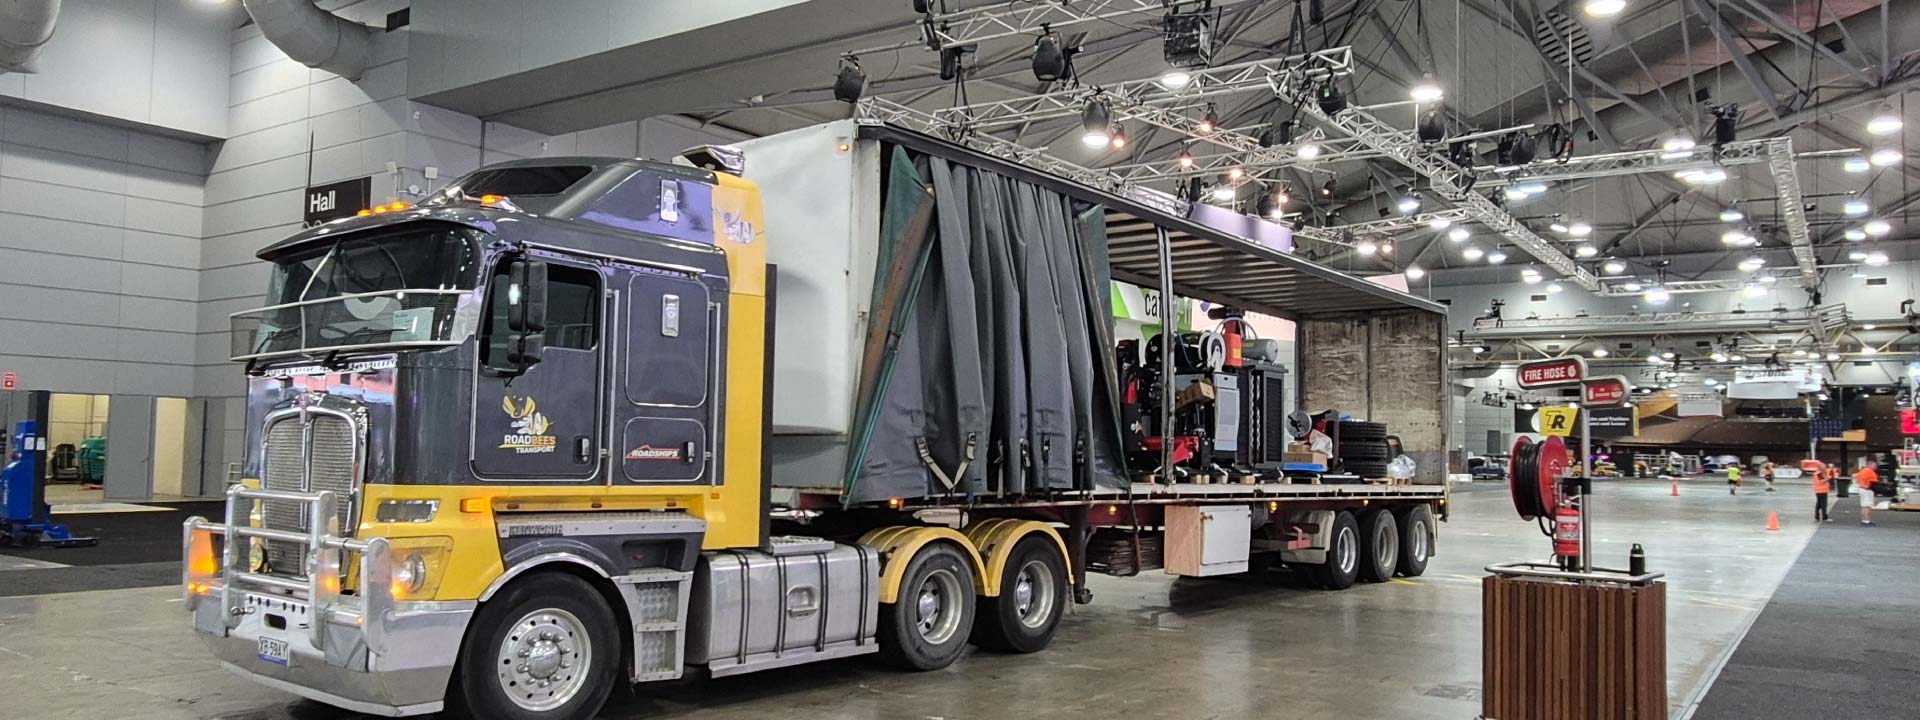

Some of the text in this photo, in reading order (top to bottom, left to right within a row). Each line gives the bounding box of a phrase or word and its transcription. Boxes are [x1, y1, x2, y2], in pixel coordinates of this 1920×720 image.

[310, 190, 336, 213] Hall
[1525, 367, 1566, 381] FIRE HOSE
[503, 434, 557, 445] ROADBEES
[632, 449, 679, 457] ROADSHIPS
